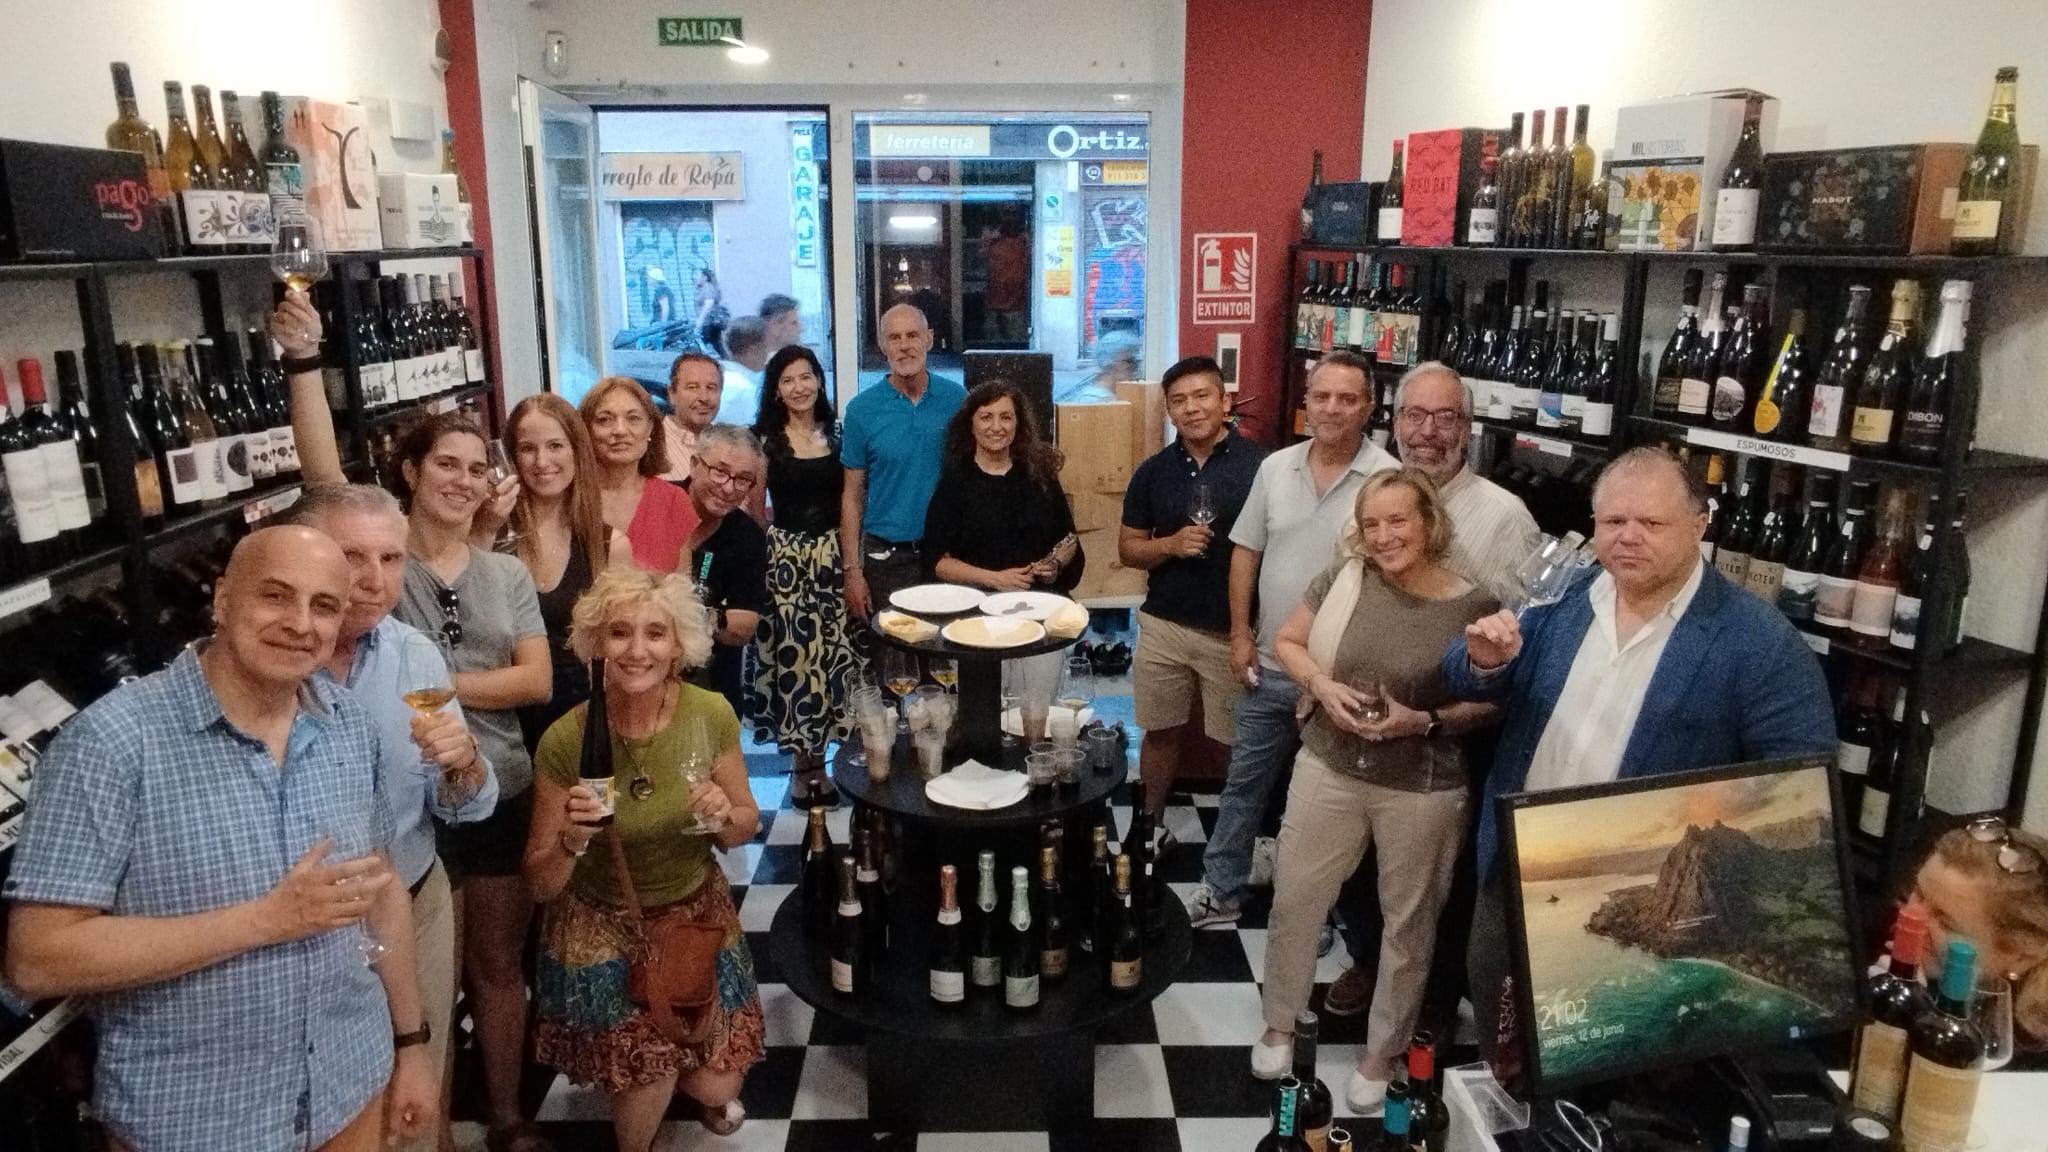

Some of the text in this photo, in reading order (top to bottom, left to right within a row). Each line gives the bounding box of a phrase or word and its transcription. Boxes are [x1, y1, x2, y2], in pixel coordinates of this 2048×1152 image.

[665, 20, 736, 41] SALIDA
[659, 163, 679, 186] de
[684, 157, 737, 191] Ropa
[95, 179, 149, 232] pago
[794, 145, 816, 260] GARAJE
[1198, 301, 1251, 317] EXTINTOR
[1736, 439, 1796, 458] ESPUMOSOS
[1542, 1024, 1625, 1049] viernes, 12 de junio
